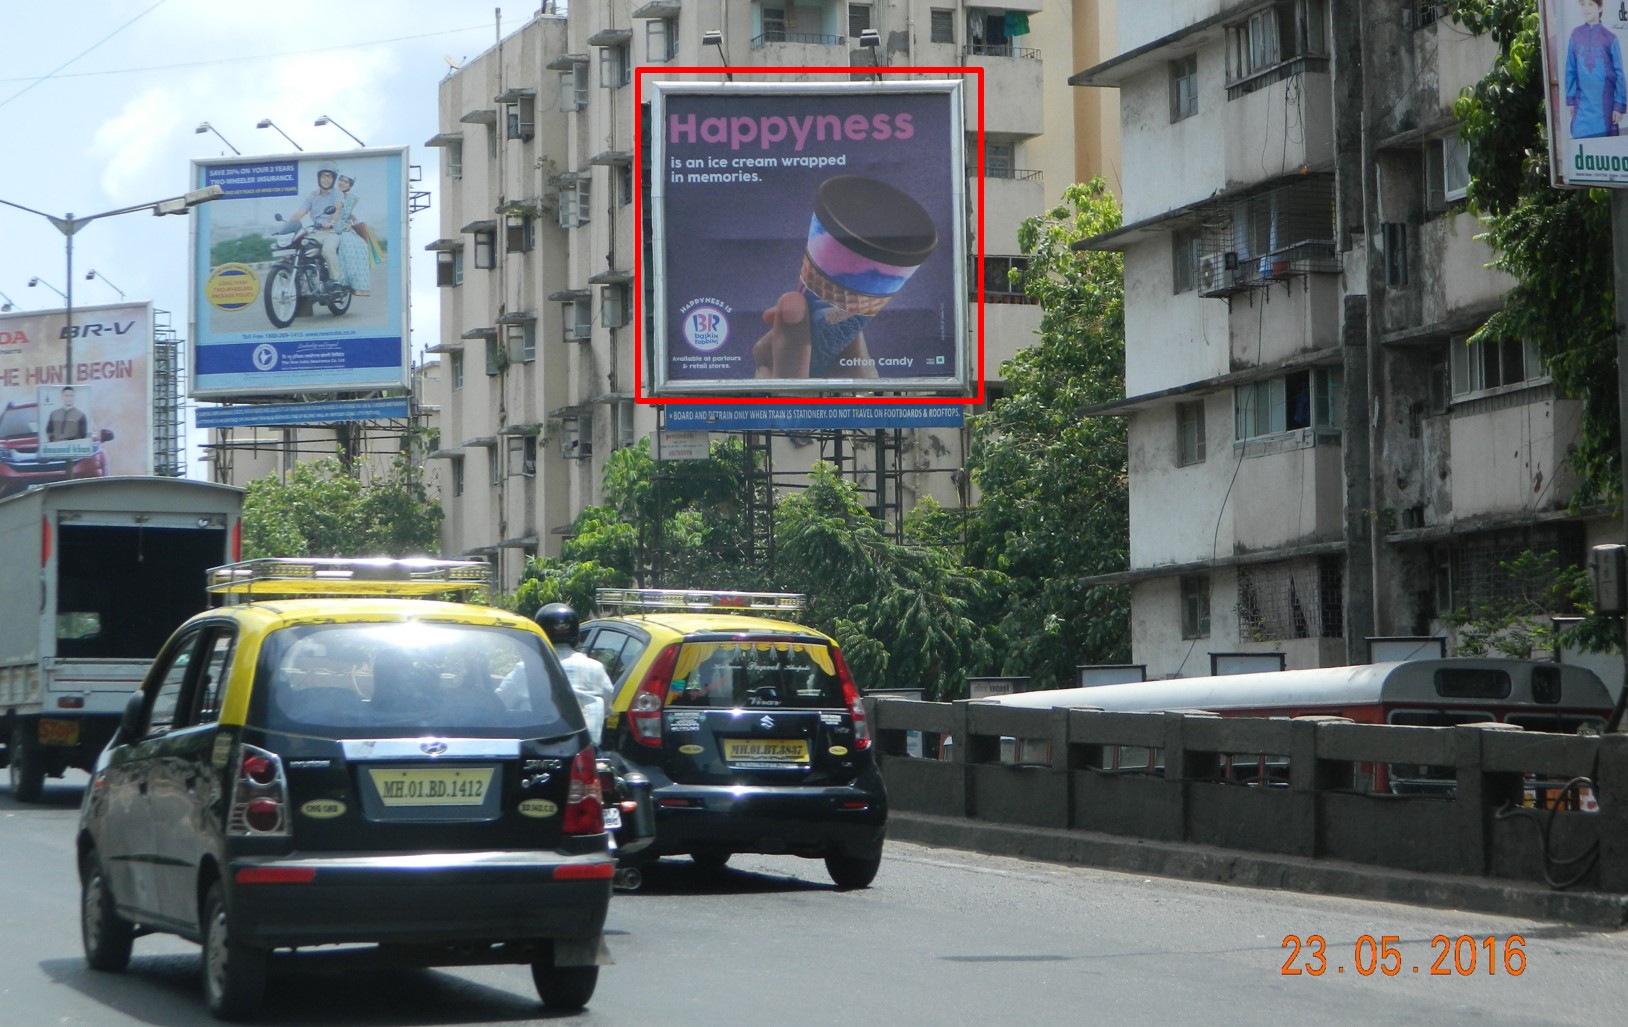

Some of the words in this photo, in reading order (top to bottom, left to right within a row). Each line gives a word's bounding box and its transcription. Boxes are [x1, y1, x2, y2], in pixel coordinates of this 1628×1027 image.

[670, 113, 914, 151] Happyness
[671, 156, 682, 168] is
[686, 158, 704, 168] an
[708, 156, 728, 168] ice
[732, 157, 778, 168] cream
[781, 154, 846, 169] wrapped
[252, 166, 269, 174] YOUR
[671, 171, 683, 183] in
[688, 170, 762, 182] memories.
[211, 177, 255, 185] TWO-WHEELER
[256, 174, 294, 182] INSURANCE.
[680, 297, 725, 313] HAPPYNESS
[725, 305, 733, 313] IS
[59, 321, 135, 340] BR-V
[712, 355, 741, 363] parlours
[839, 358, 875, 366] Cotton
[878, 356, 914, 367] Candy
[77, 360, 132, 381] BEGIN
[673, 411, 693, 420] BOARD
[695, 411, 707, 420] AND
[734, 410, 748, 420] ONLY
[749, 410, 767, 420] WHEN
[768, 410, 786, 419] TRAIN
[787, 410, 793, 419] IS
[793, 409, 827, 419] STATIONERY.
[829, 409, 838, 418] DO
[839, 409, 851, 418] NOT
[852, 409, 873, 418] TRAVEL
[874, 409, 882, 418] ON
[884, 408, 922, 418] FOOTBOARDS
[923, 409, 928, 418] &
[929, 408, 960, 417] ROOFTOPS.
[383, 780, 483, 798] MH.01.BD.1412
